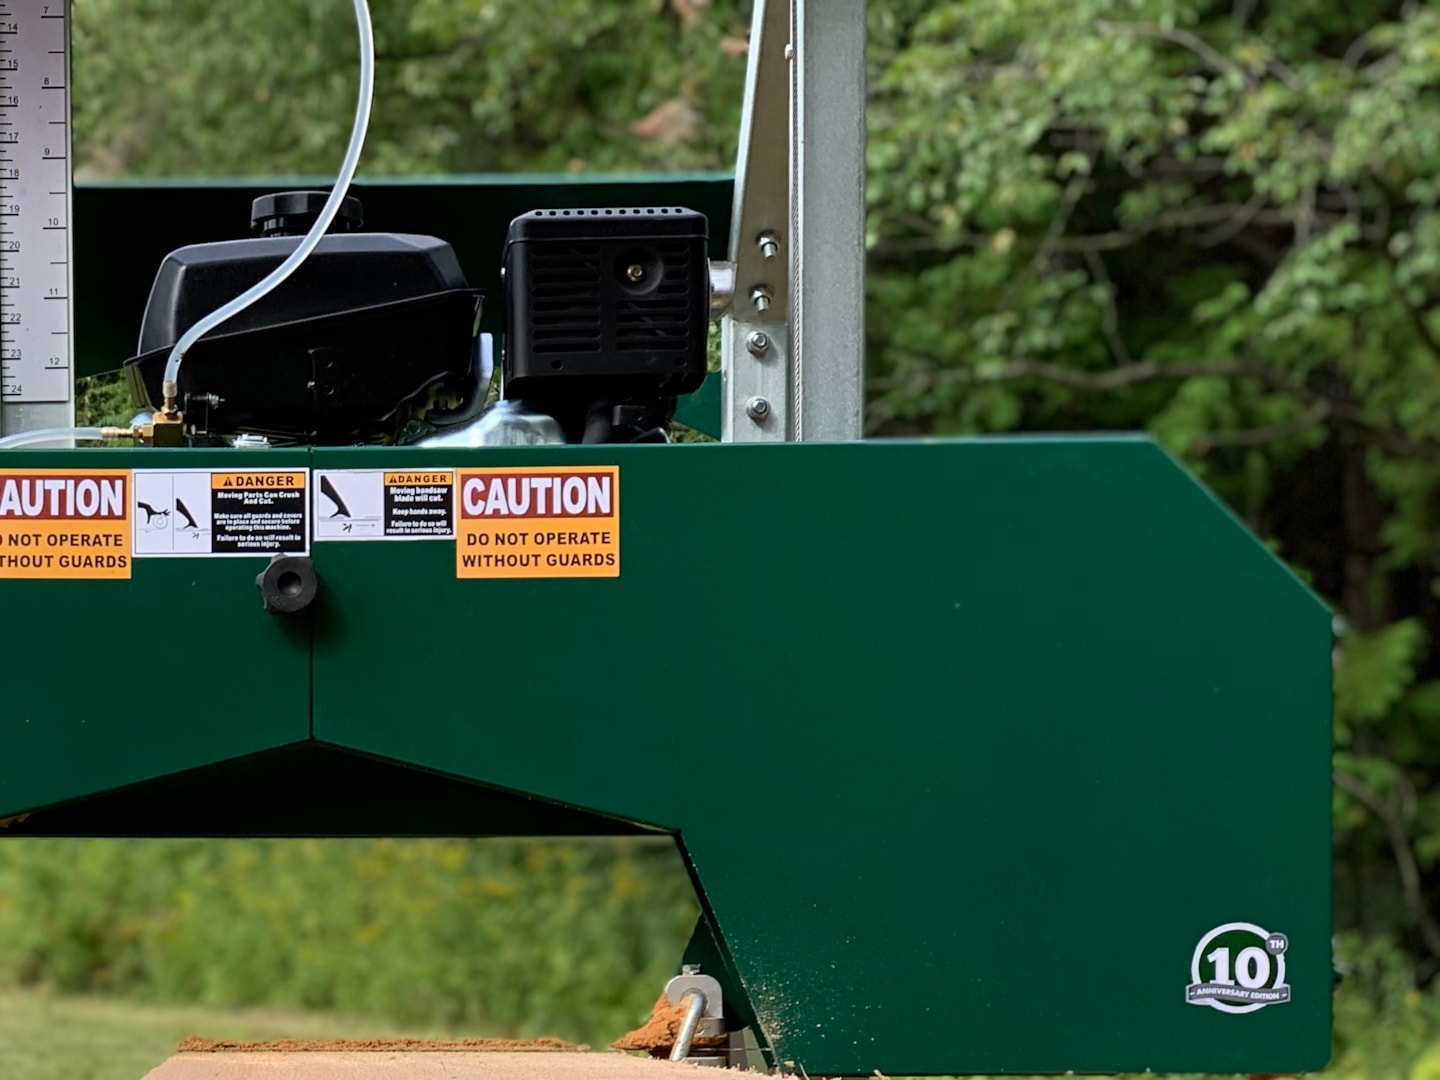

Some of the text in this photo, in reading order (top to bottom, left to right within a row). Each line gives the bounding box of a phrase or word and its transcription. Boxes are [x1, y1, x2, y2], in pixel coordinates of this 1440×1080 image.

[43, 6, 49, 14] 7
[8, 23, 18, 31] 14
[8, 60, 18, 68] 15
[44, 77, 50, 85] 8
[8, 96, 19, 104] 16
[8, 132, 19, 140] 17
[44, 147, 50, 155] 9
[9, 168, 19, 176] 18
[9, 204, 20, 213] 19
[48, 218, 59, 226] 10
[9, 241, 20, 249] 20
[9, 277, 20, 285] 21
[10, 313, 21, 321] 22
[10, 349, 22, 357] 23
[49, 357, 60, 365] 12
[11, 385, 22, 393] 24
[236, 476, 295, 487] DANGER
[398, 474, 447, 483] DANGER
[279, 491, 300, 499] Crush
[463, 476, 611, 516] CAUTION
[8, 533, 42, 547] NOT
[47, 533, 123, 547] OPERATE
[466, 532, 611, 546] DO NOT OPERATE
[59, 555, 127, 568] GUARDS
[462, 553, 616, 567] WITHOUT GUARDS
[1207, 939, 1284, 989] 10 TH
[1196, 987, 1280, 1000] ANNIVERSARY EDITION
